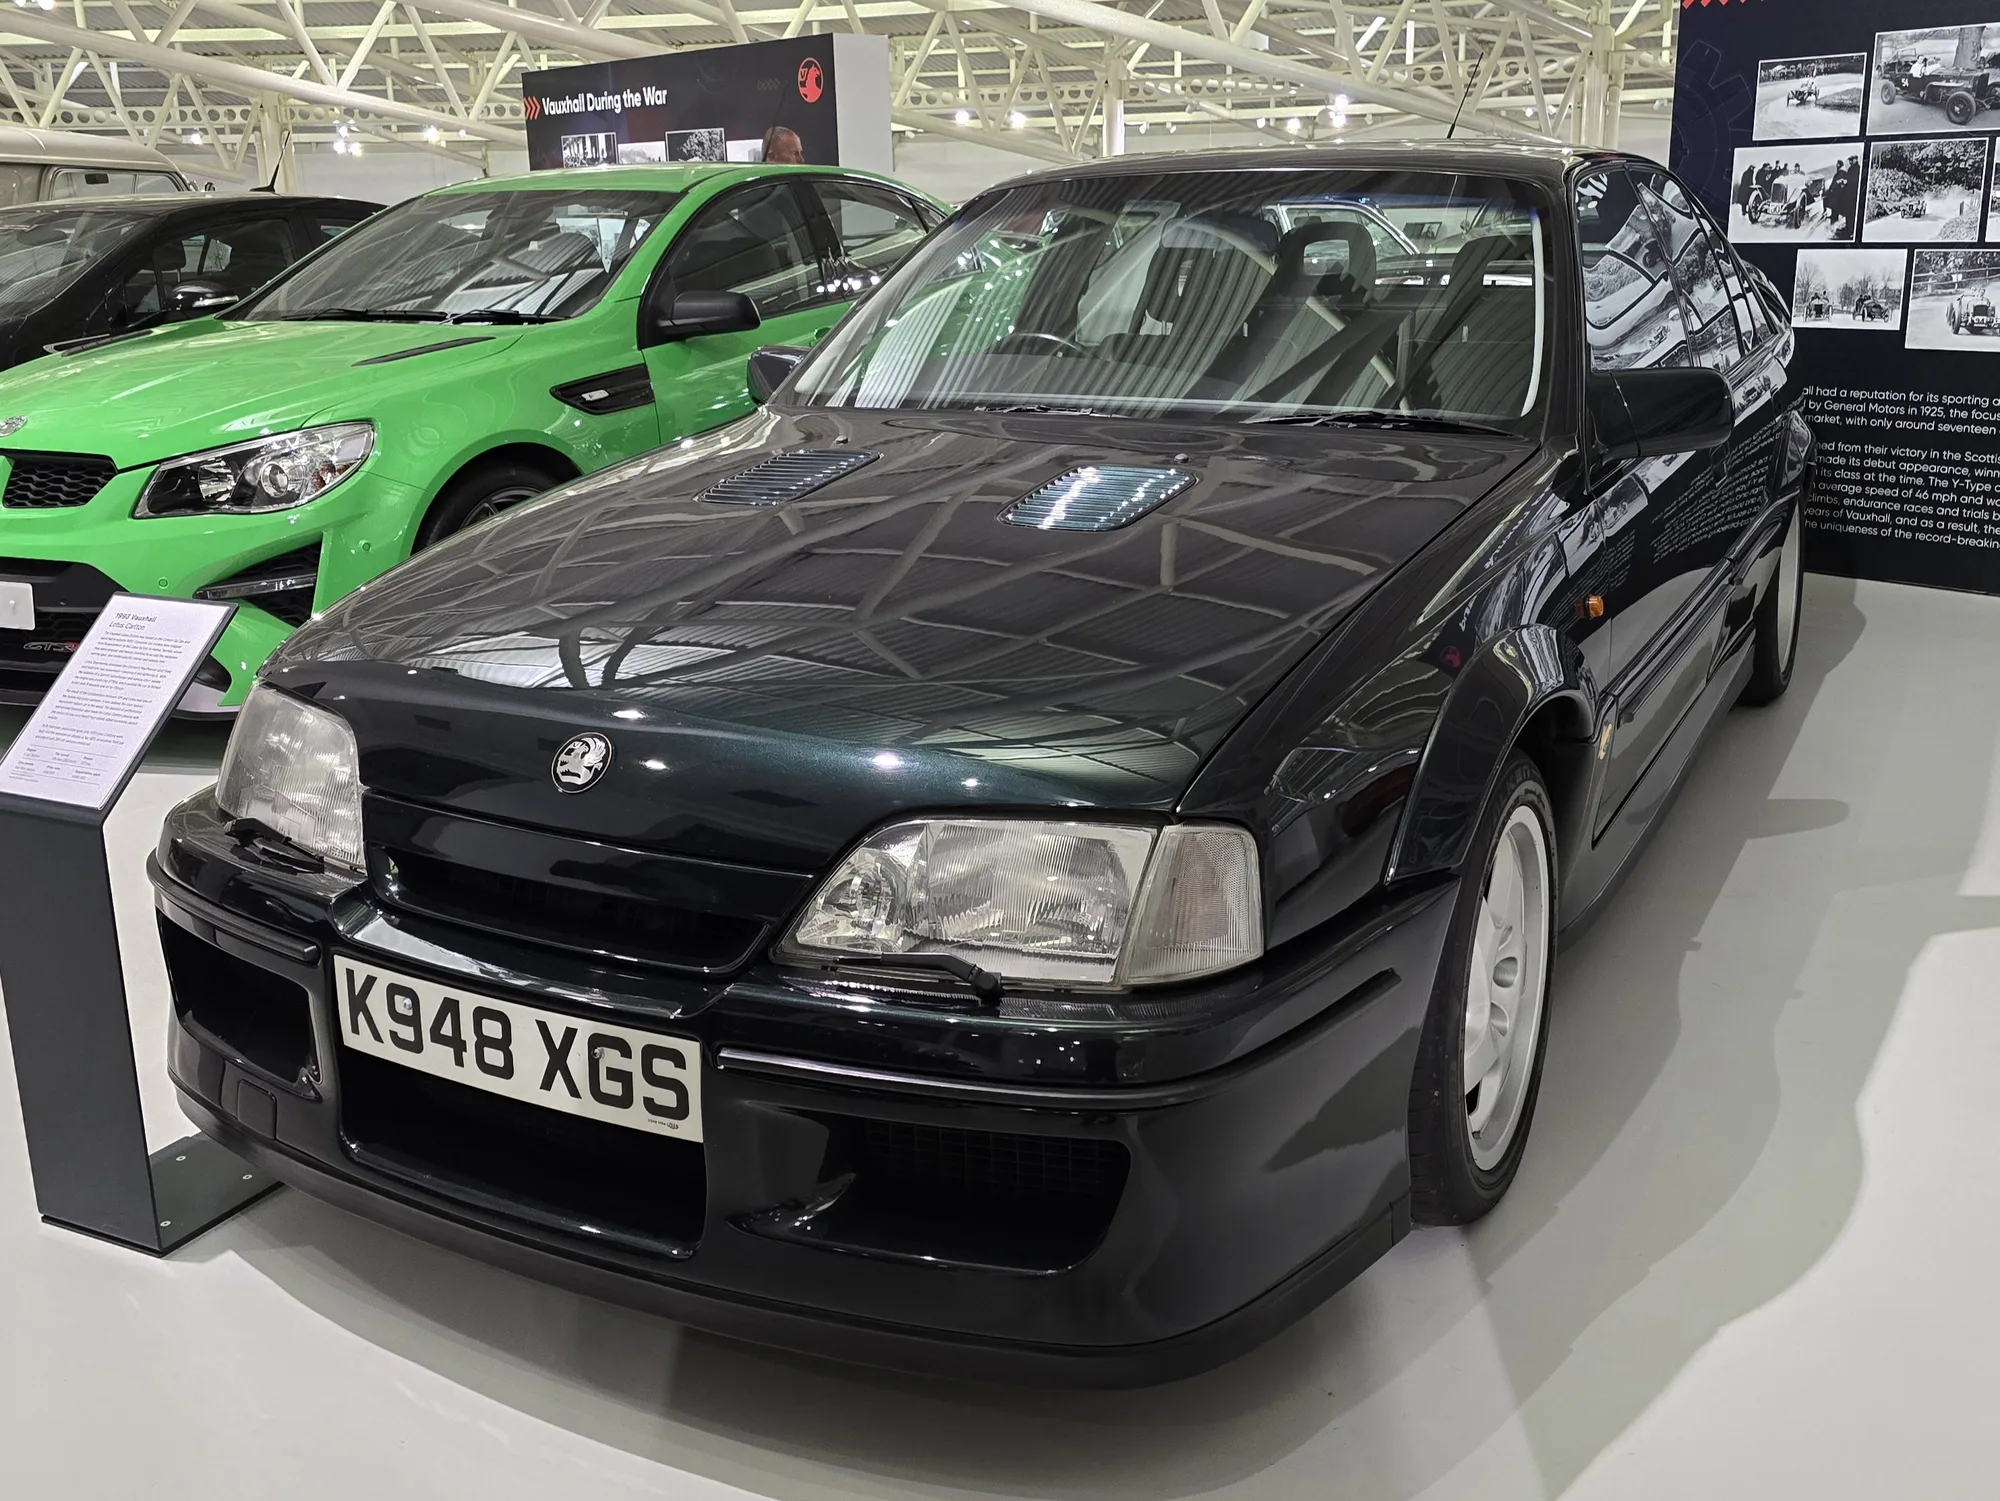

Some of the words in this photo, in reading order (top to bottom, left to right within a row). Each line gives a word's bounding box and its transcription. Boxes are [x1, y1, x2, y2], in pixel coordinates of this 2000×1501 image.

[542, 93, 585, 115] Vauxhall
[586, 91, 622, 114] During
[622, 89, 641, 108] the
[642, 86, 667, 106] War
[1816, 386, 1837, 397] had
[1840, 389, 1847, 397] a
[1850, 390, 1906, 401] reputation
[1909, 390, 1923, 401] for
[1926, 392, 1939, 403] its
[1942, 394, 1989, 408] sporting
[1808, 399, 1821, 411] by
[1824, 400, 1866, 412] General
[1869, 402, 1905, 415] Motors
[1907, 405, 1917, 415] in
[1920, 405, 1946, 418] 1925,
[1949, 408, 1968, 418] the
[1971, 409, 2000, 421] focus
[1804, 414, 1842, 426] market,
[1845, 416, 1867, 425] with
[1870, 417, 1893, 430] only
[1895, 420, 1935, 430] around
[1937, 423, 1996, 435] seventeen
[1838, 441, 1861, 452] from
[1864, 444, 1888, 455] their
[1891, 445, 1928, 460] victory
[1930, 448, 1940, 459] in
[1943, 450, 1961, 460] the
[1964, 451, 2000, 464] Scottis
[1816, 455, 1846, 465] made
[1848, 456, 1861, 466] its
[1863, 458, 1896, 469] debut
[1899, 462, 1971, 477] appearance,
[1974, 467, 2000, 478] winn
[1820, 467, 1832, 477] its
[1834, 468, 1861, 480] class
[1863, 472, 1875, 481] at
[1878, 472, 1896, 483] the
[1899, 475, 1925, 485] time.
[1928, 476, 1948, 487] The
[1952, 478, 1991, 493] Y-Type
[1818, 482, 1862, 496] average
[1865, 486, 1899, 497] speed
[1901, 488, 1913, 498] of
[1914, 489, 1929, 499] 46
[1932, 492, 1957, 503] mph
[1960, 495, 1984, 505] and
[1843, 498, 1901, 511] endurance
[1903, 503, 1934, 514] races
[1936, 507, 1959, 517] and
[1962, 508, 1990, 520] trials
[1804, 507, 1830, 517] years
[1833, 508, 1844, 517] of
[1845, 509, 1893, 525] Vauxhall,
[1895, 517, 1918, 526] and
[1920, 519, 1934, 528] as
[1936, 521, 1944, 529] a
[1947, 522, 1980, 535] result,
[1984, 524, 2000, 535] the
[1804, 519, 1818, 528] he
[1820, 521, 1878, 536] uniqueness
[1880, 527, 1892, 537] of
[1894, 529, 1912, 539] the
[1915, 532, 2000, 551] record-breakin
[125, 622, 145, 630] Carlton
[131, 613, 158, 622] Vauxhall
[345, 967, 514, 1081] K948
[534, 1019, 690, 1121] XGS
